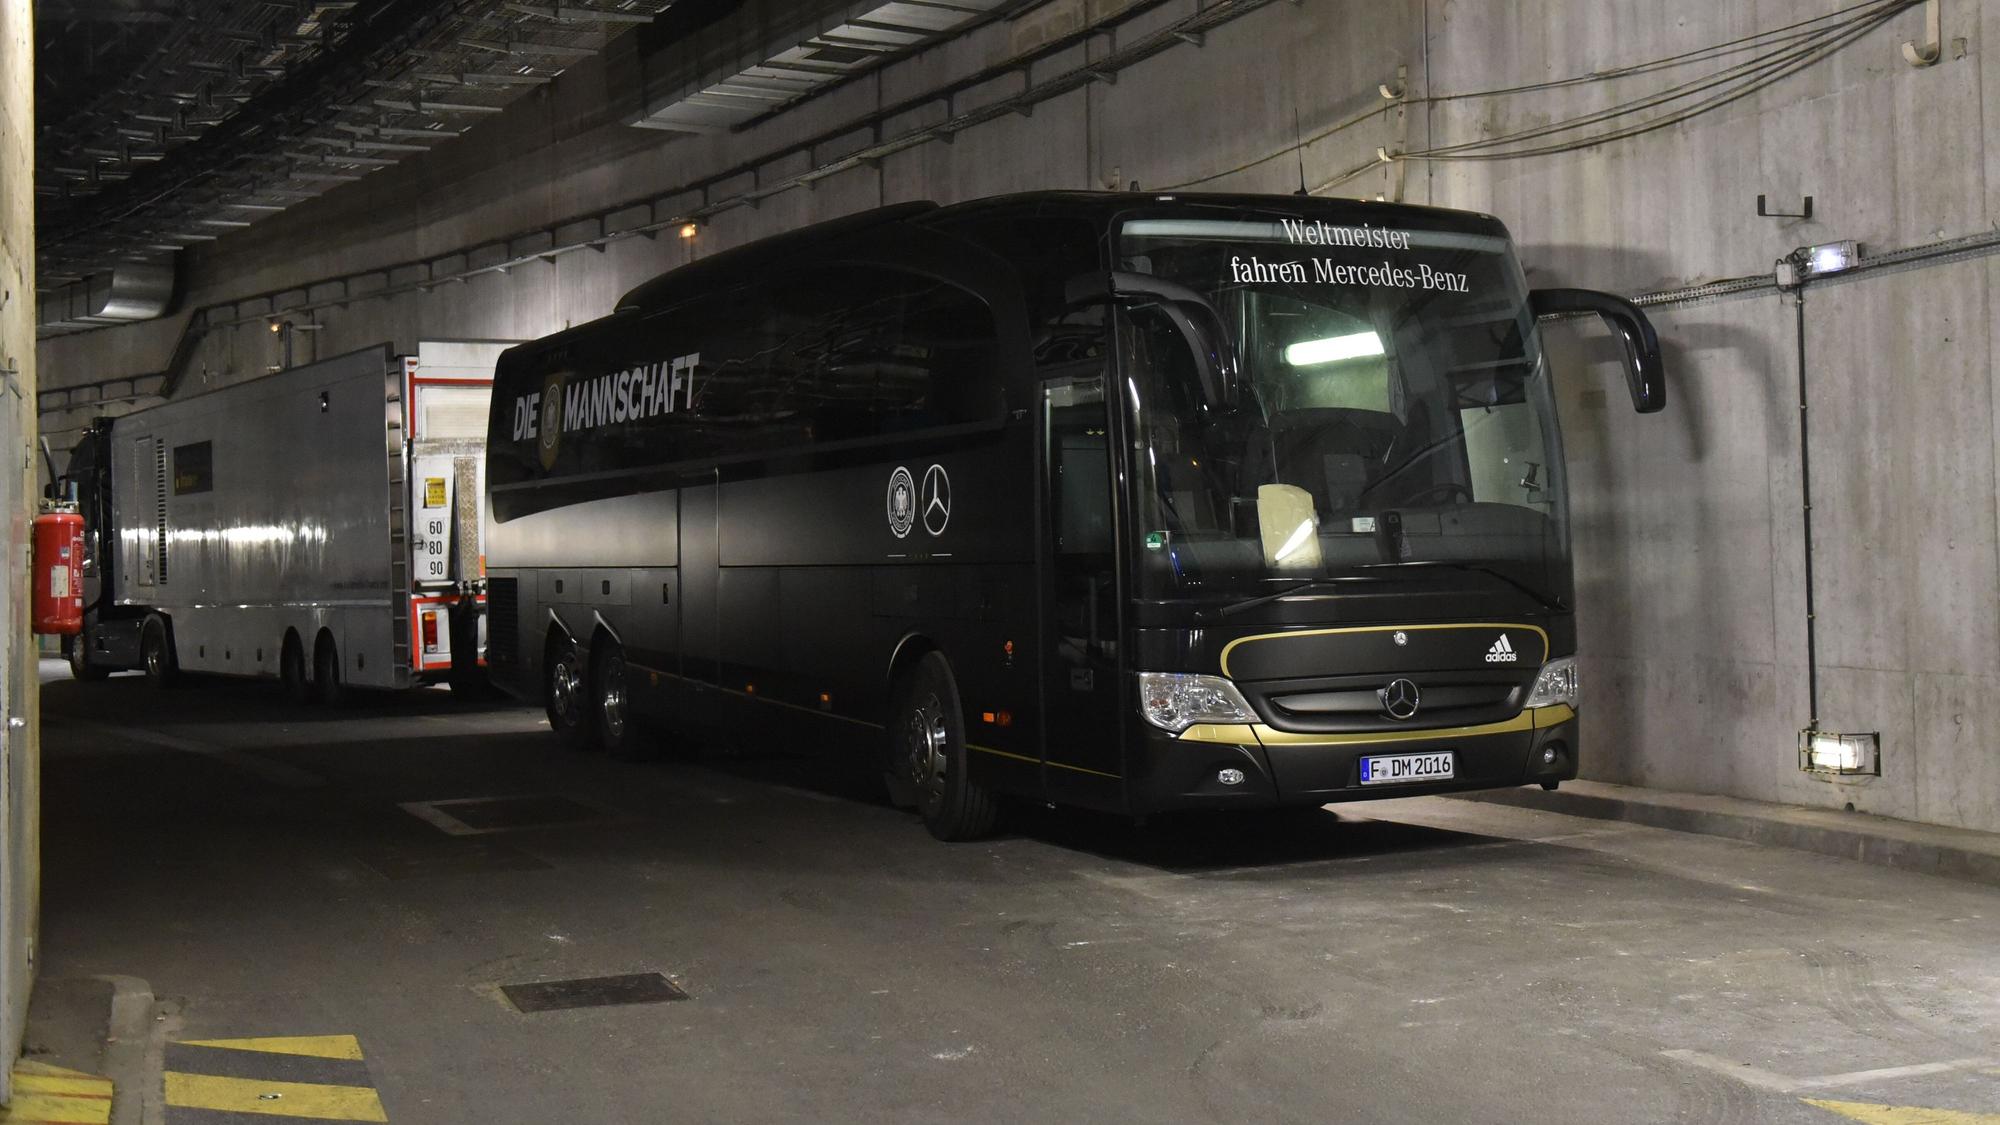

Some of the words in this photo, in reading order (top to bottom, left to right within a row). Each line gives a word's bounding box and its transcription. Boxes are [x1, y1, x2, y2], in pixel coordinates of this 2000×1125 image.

[1281, 218, 1410, 250] Weltmeister
[1231, 256, 1308, 284] fahren
[1312, 258, 1469, 293] Mercedes-Benz
[513, 392, 540, 442] DIE
[563, 352, 700, 432] MANNSCHAFT
[430, 521, 442, 534] 60
[429, 541, 442, 555] 80
[430, 561, 443, 575] 90
[1485, 651, 1517, 663] adidas
[1371, 761, 1380, 778] F
